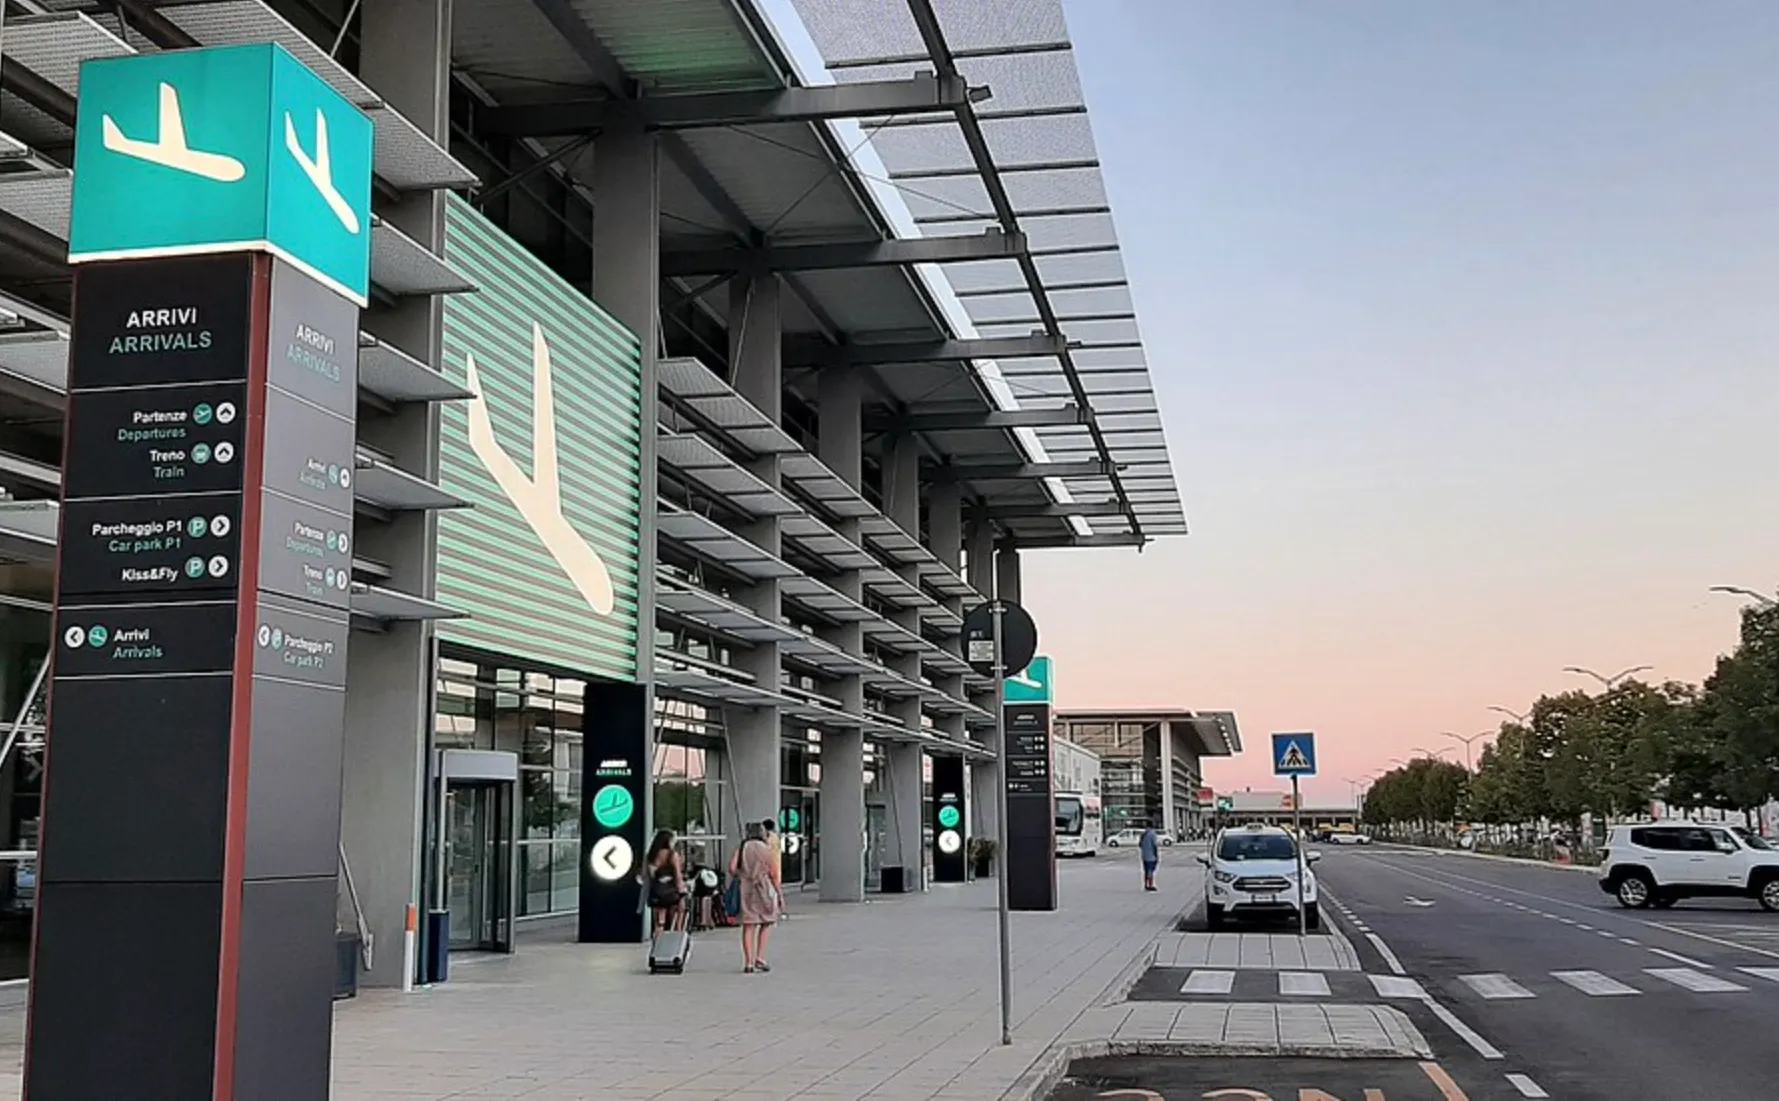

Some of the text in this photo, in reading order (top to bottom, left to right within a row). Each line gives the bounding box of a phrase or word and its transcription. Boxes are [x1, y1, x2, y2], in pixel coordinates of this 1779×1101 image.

[126, 307, 197, 329] ARRIVI
[108, 331, 212, 354] ARRIVALS
[296, 324, 335, 356] ARRIVI
[286, 344, 341, 383] ARRIVALS
[133, 410, 188, 424] Partenze
[117, 427, 187, 442] Departures
[150, 449, 186, 462] Treno
[153, 466, 185, 478] Train
[92, 521, 164, 537] Parcheggio
[166, 520, 182, 532] P1
[108, 537, 181, 553] Car park P1
[121, 566, 179, 583] Kiss&Fly
[113, 628, 150, 642] Arrivi
[112, 645, 163, 659] Arrivals
